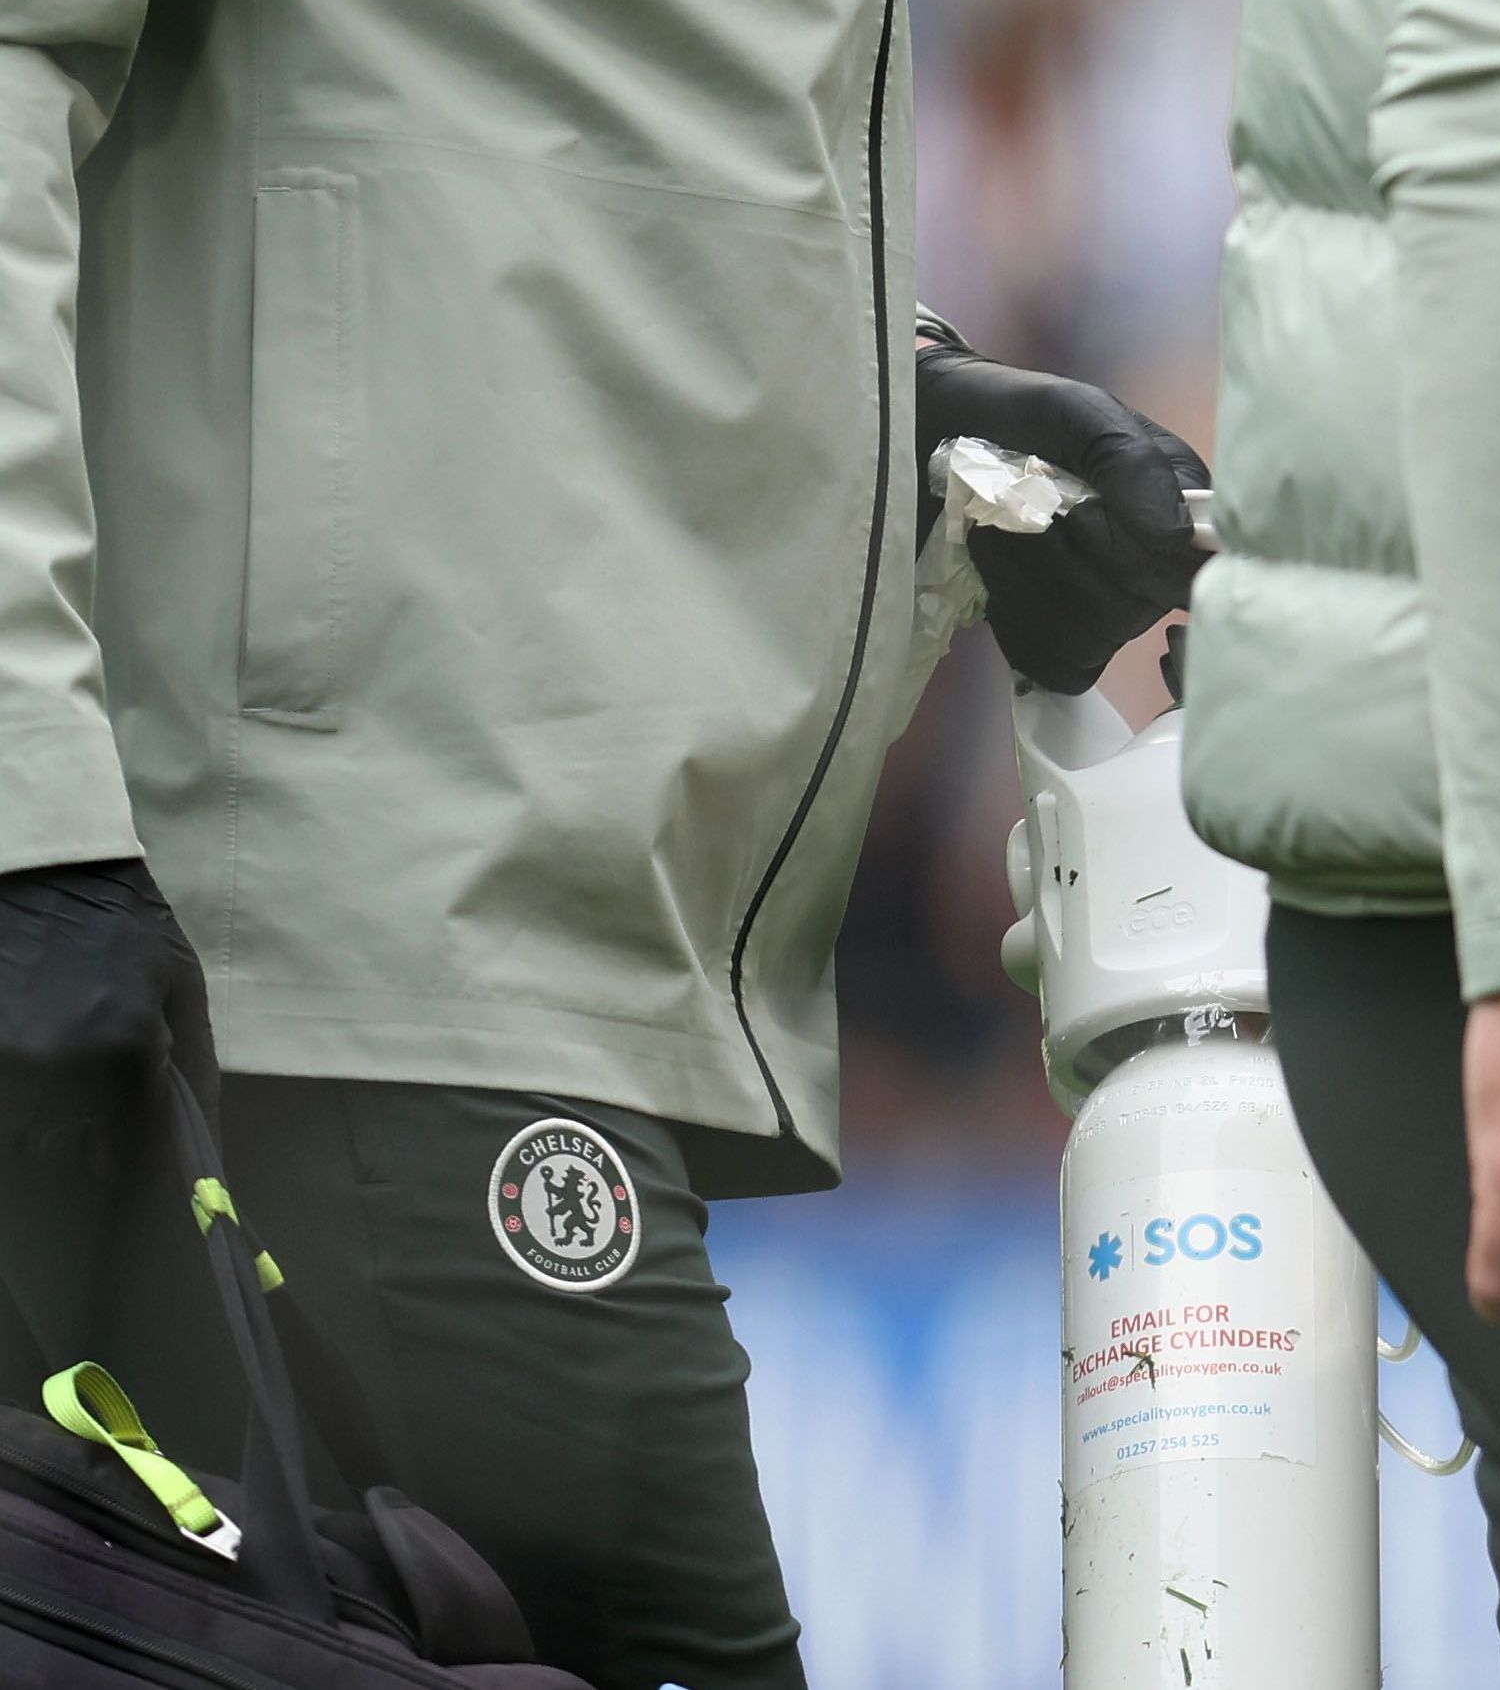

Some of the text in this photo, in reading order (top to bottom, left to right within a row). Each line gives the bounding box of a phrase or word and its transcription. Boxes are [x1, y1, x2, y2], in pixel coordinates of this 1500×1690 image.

[519, 1134, 605, 1169] CHELSEA
[1144, 1213, 1263, 1266] SOS
[526, 1248, 621, 1277] FOOTBALL CLUB
[1111, 1304, 1230, 1339] EMAIL FOR
[1072, 1329, 1296, 1384] EXCHANGE CYLINDERS
[1076, 1361, 1283, 1406] callout@specalityoxygen.co.uk
[1082, 1402, 1272, 1444] www.specialityoxygen.co.uk
[1116, 1433, 1221, 1461] 01257 254 525
